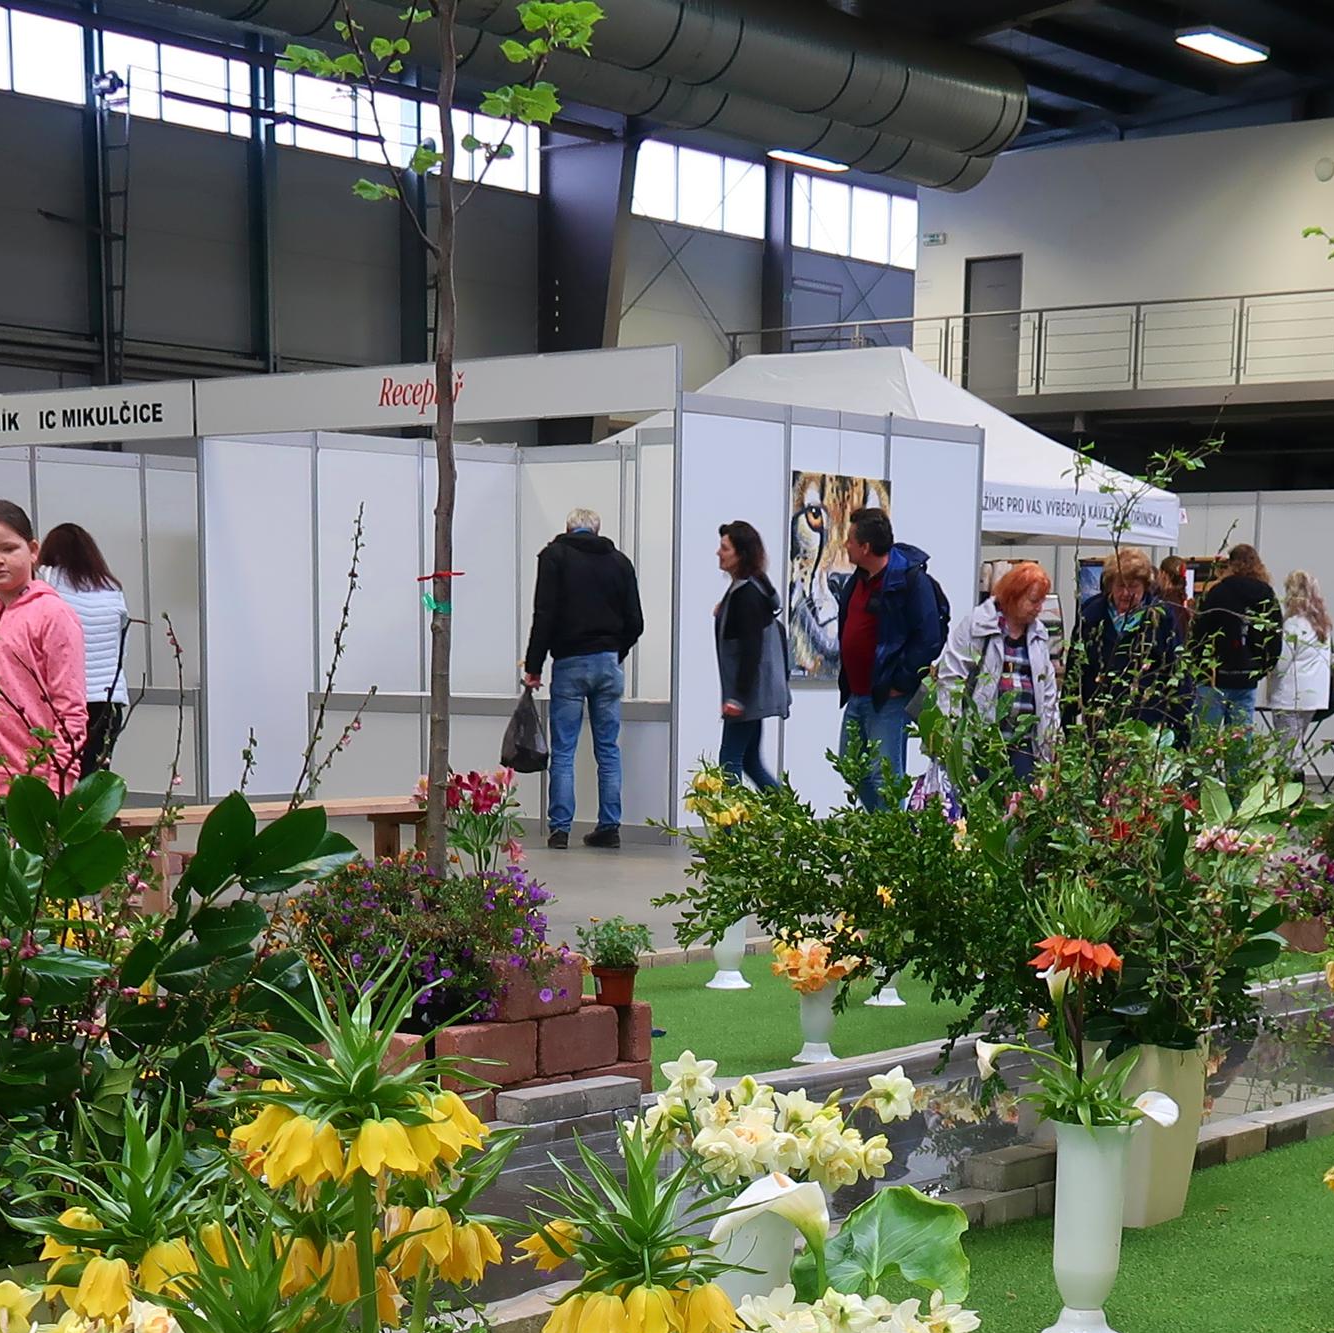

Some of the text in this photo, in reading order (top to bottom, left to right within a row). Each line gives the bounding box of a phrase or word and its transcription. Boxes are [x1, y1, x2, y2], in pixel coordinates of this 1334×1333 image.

[378, 371, 465, 415] Recepř
[39, 410, 57, 430] IC
[62, 401, 163, 429] MIKULČICE
[982, 492, 1004, 512] ŽÍME
[1007, 497, 1025, 513] PRO
[1088, 502, 1108, 519] KÁVA
